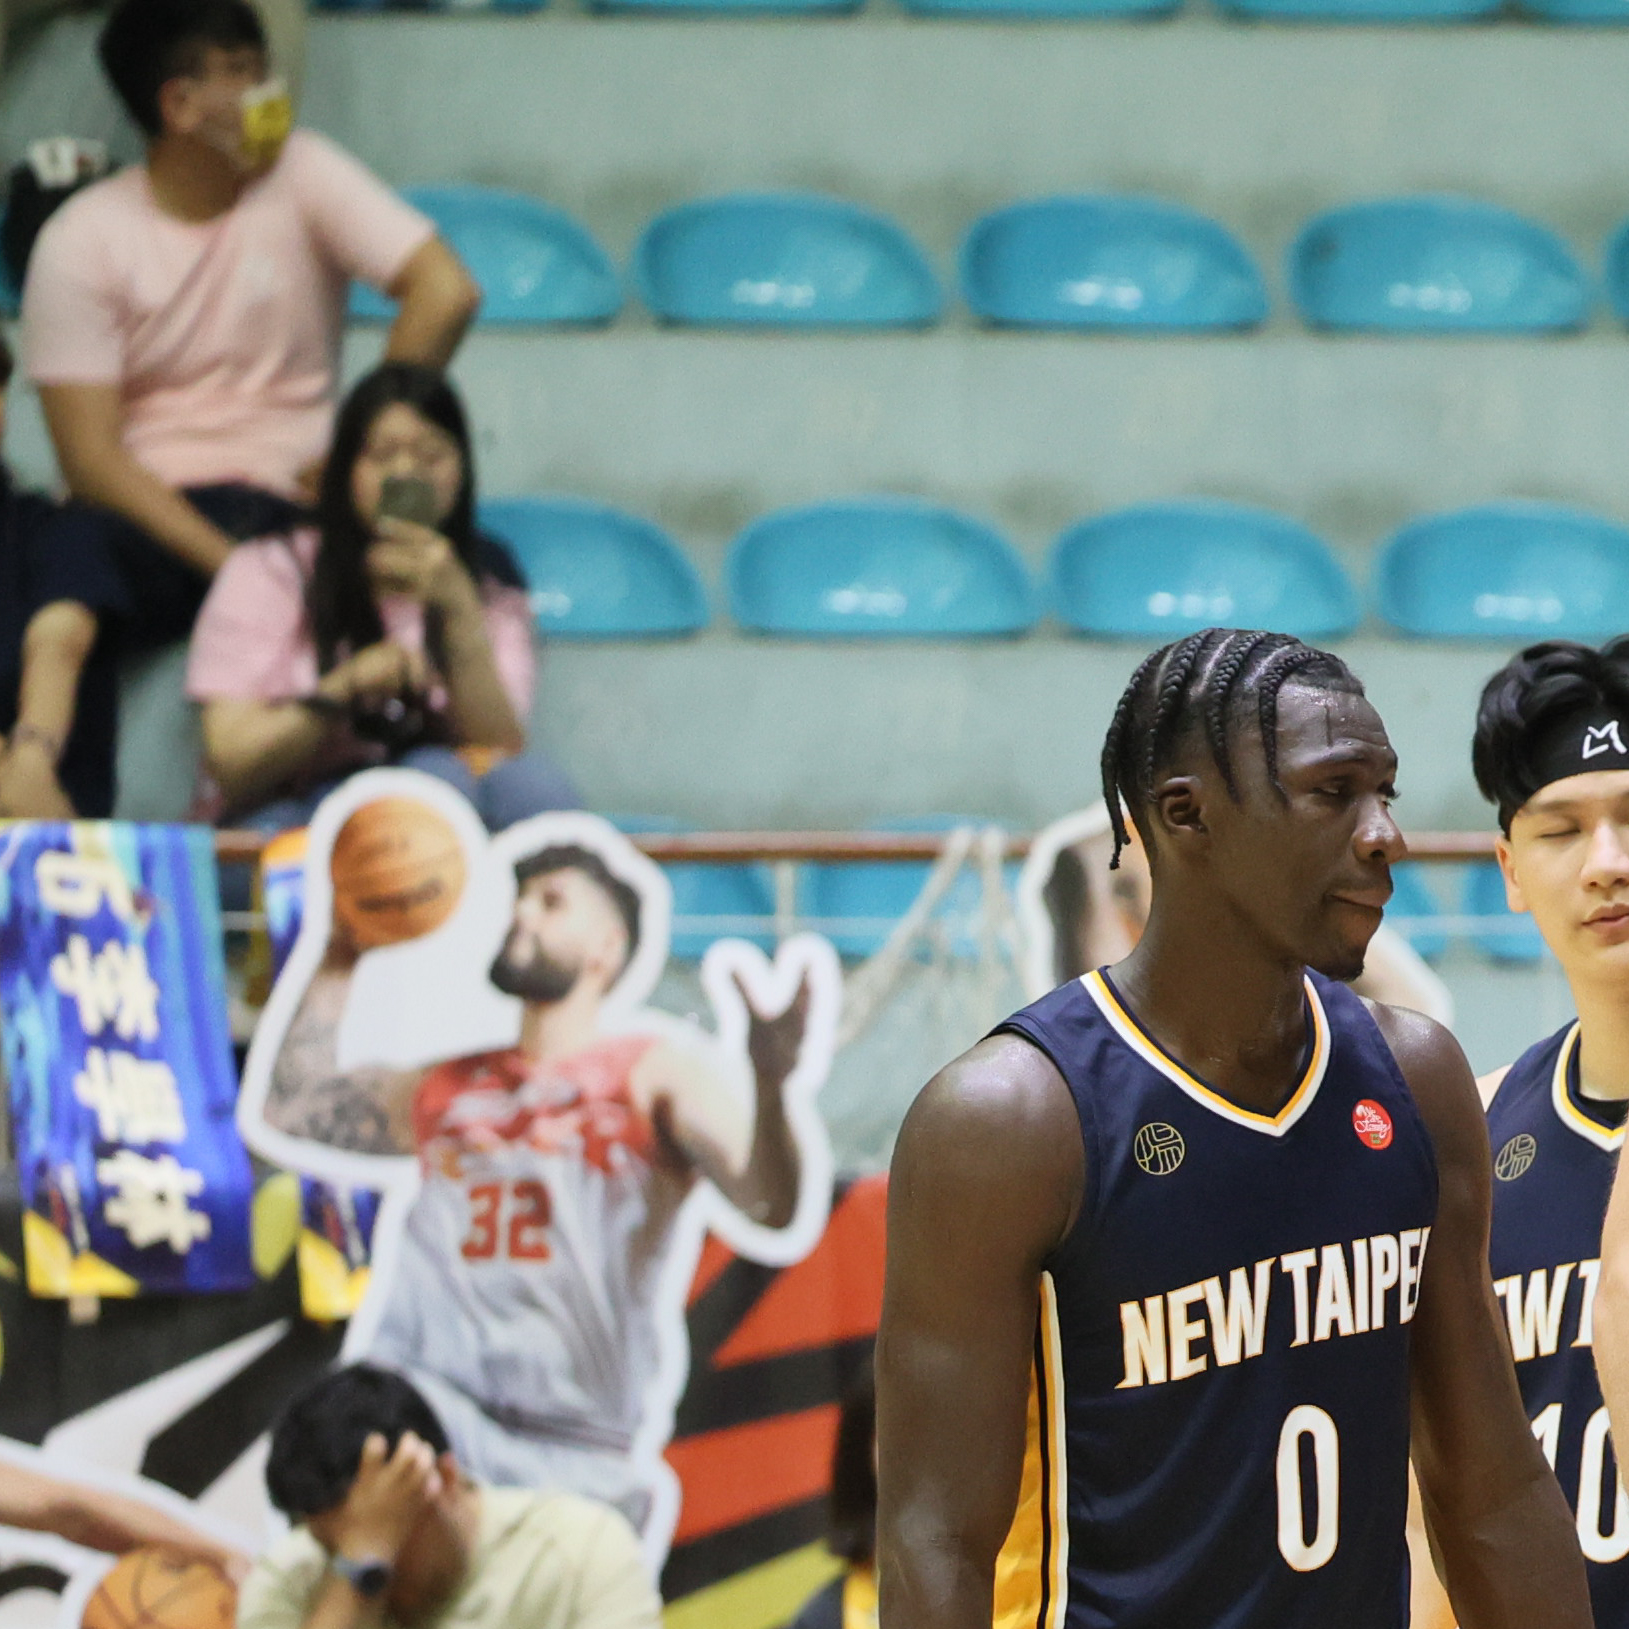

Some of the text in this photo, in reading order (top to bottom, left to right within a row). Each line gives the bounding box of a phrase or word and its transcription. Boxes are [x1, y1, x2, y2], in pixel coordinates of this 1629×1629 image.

[460, 1180, 554, 1260] 32
[1114, 1256, 1277, 1389] NEW
[1276, 1404, 1339, 1572] 0
